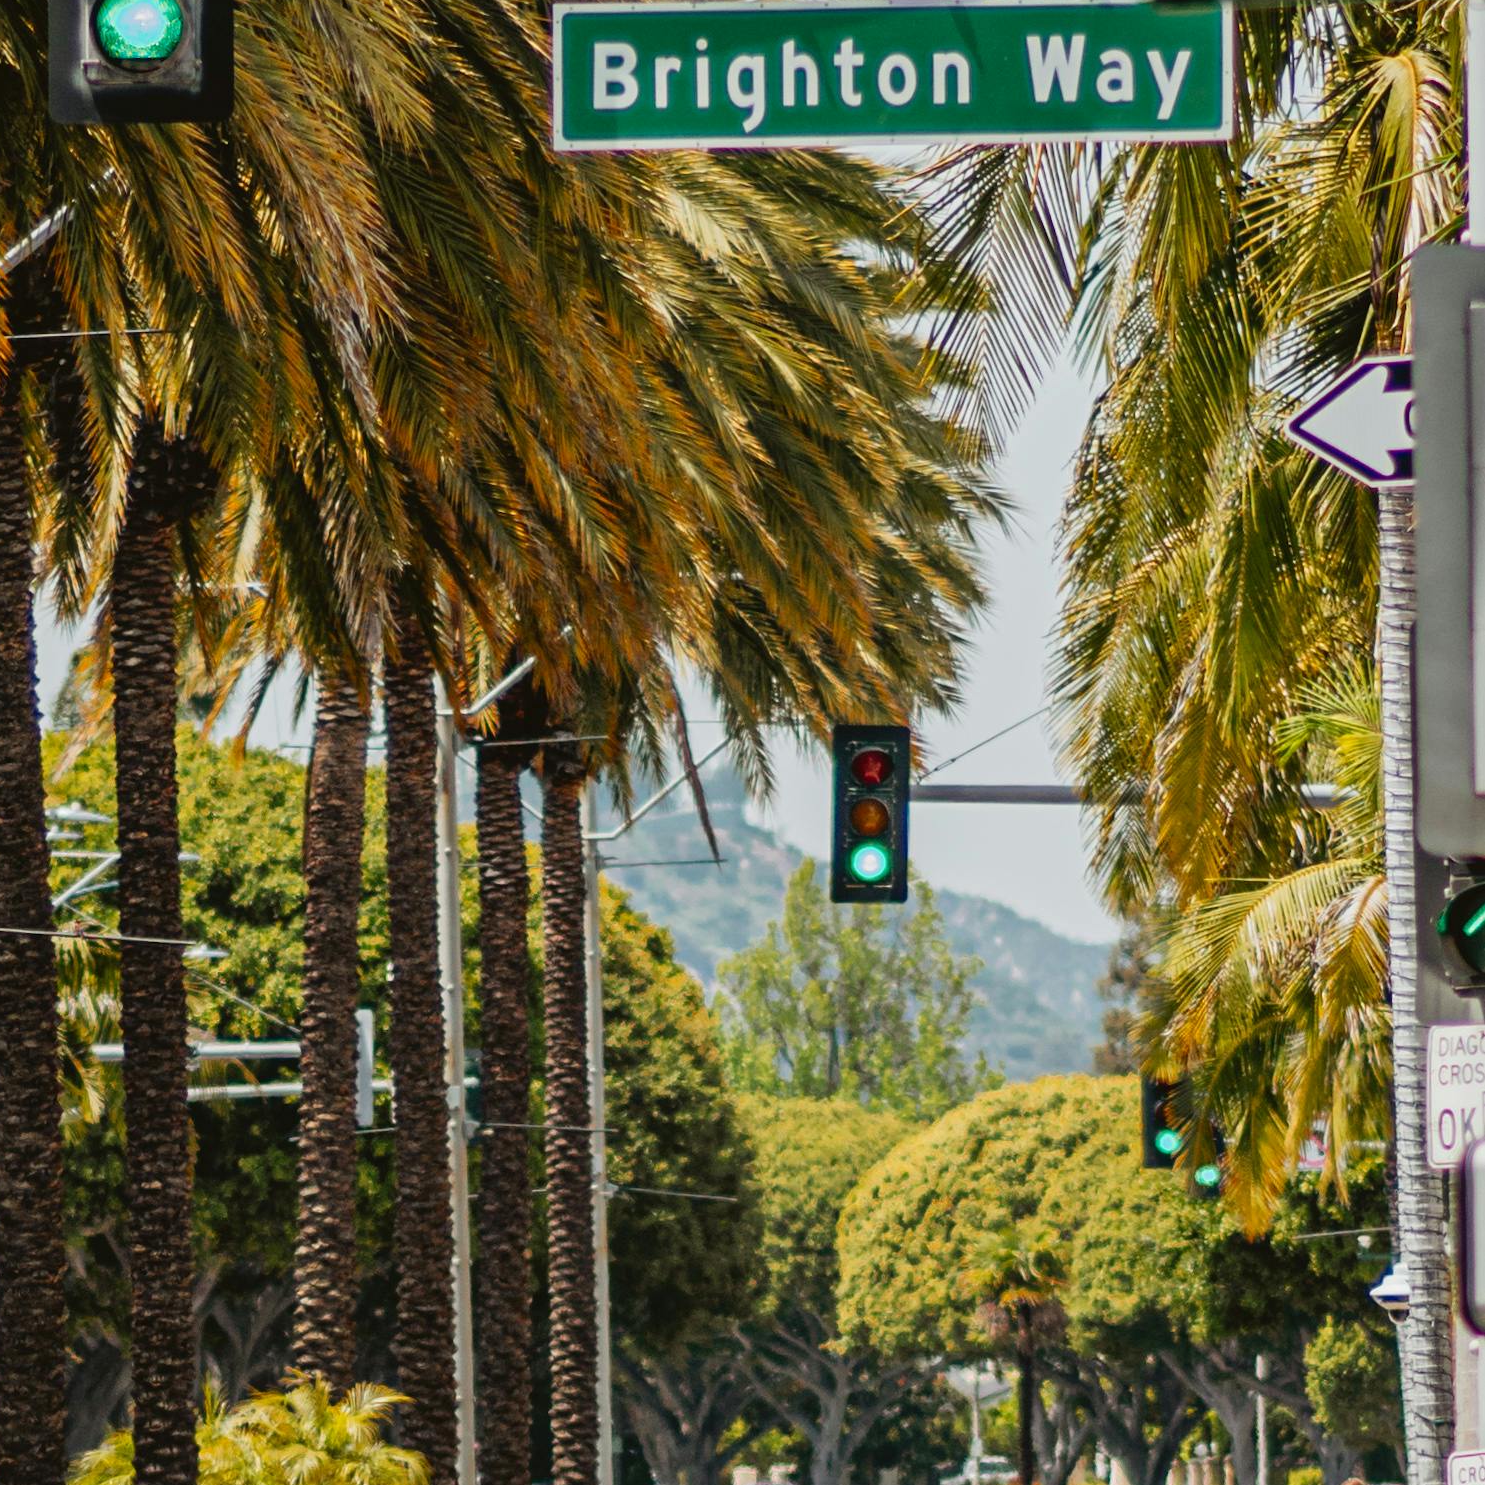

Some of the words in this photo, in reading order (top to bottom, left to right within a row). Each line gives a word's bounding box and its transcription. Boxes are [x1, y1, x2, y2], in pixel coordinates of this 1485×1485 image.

[593, 37, 971, 134] Brighton
[1026, 34, 1192, 121] Way
[1439, 1107, 1477, 1150] OK
